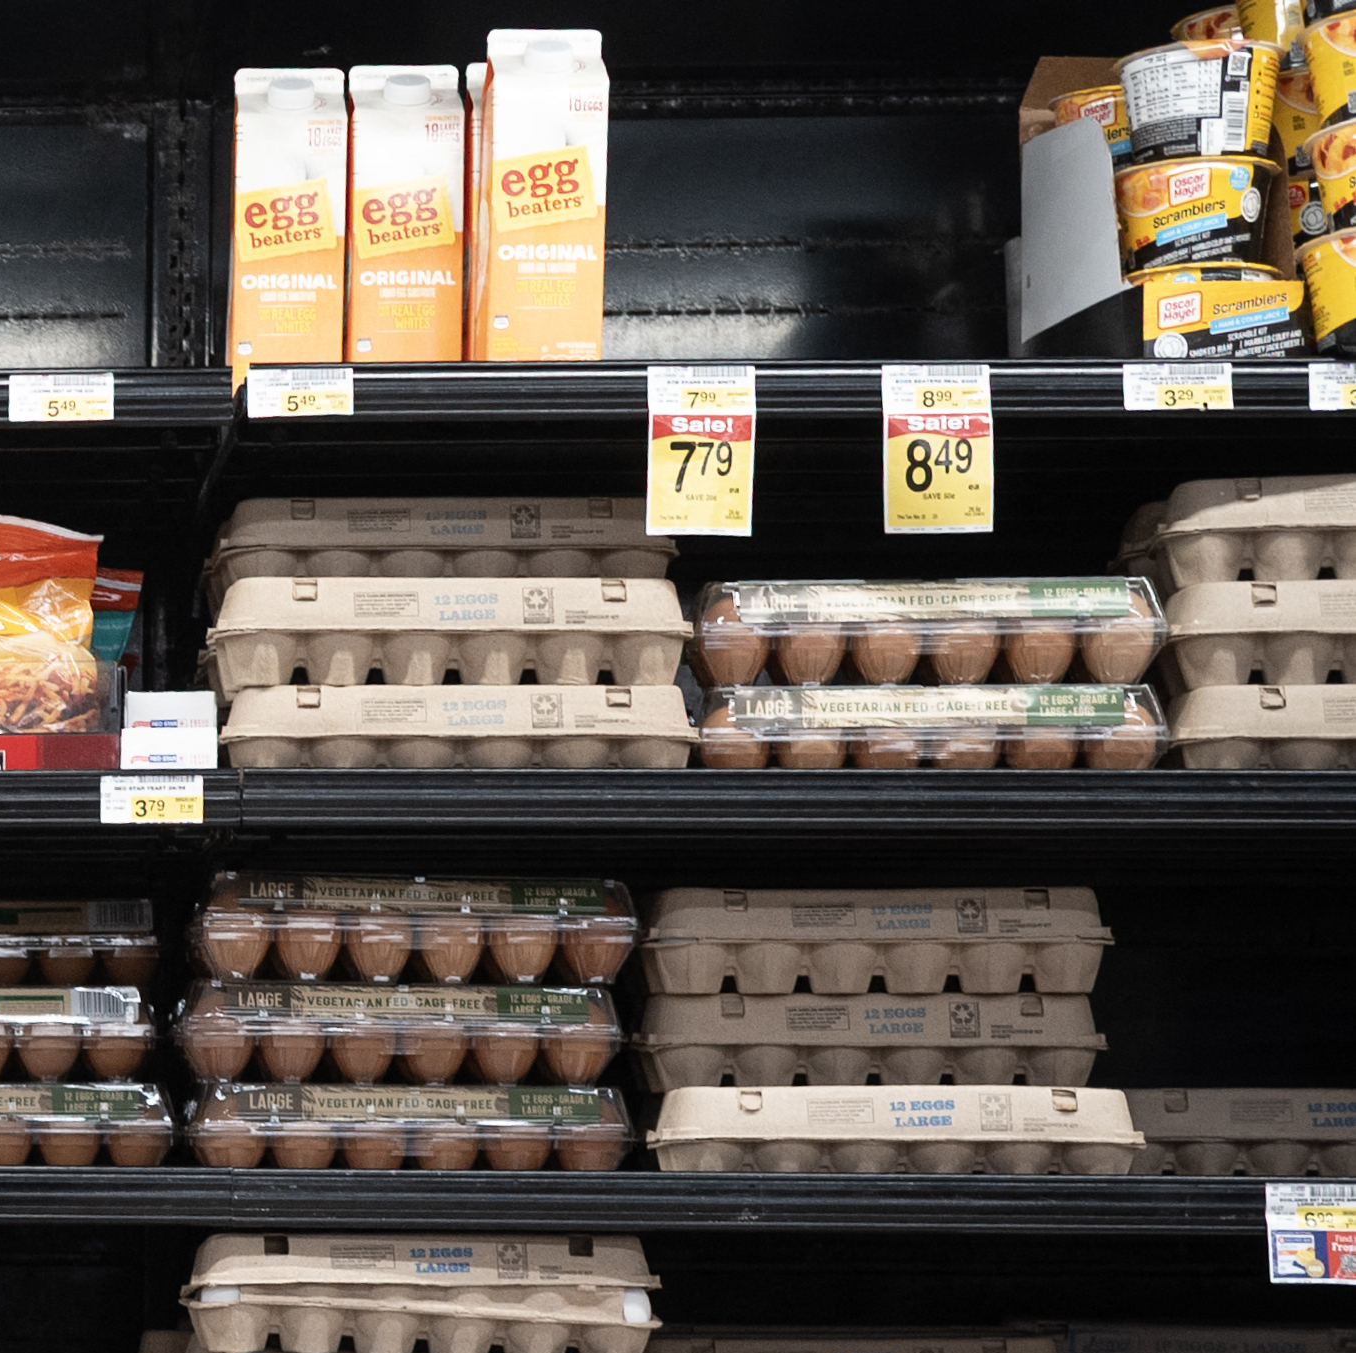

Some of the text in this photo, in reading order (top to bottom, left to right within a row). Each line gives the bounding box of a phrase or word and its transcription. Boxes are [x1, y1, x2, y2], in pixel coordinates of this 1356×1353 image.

[501, 157, 580, 199] egg
[244, 191, 319, 230] egg
[362, 188, 437, 226] egg
[508, 195, 582, 218] beaters
[1153, 200, 1226, 229] Scramblers
[250, 226, 322, 248] beaters
[367, 223, 441, 246] beaters
[497, 244, 598, 261] ORIGINAL
[241, 273, 337, 289] ORIGINAL
[359, 270, 456, 286] ORIGINAL
[1164, 297, 1195, 310] Oscar
[1213, 293, 1288, 315] Scramblers
[271, 309, 316, 319] REAL EGG
[1163, 308, 1196, 322] Mayer
[275, 321, 311, 332] WHITES
[671, 417, 733, 433] Sale!
[907, 415, 970, 431] Sale!
[442, 700, 507, 713] 12 EGGS
[745, 700, 794, 718] LARGE
[819, 701, 1008, 713] VEGETARIAN FED CAGE-FREE
[448, 713, 504, 726] LARGE
[249, 881, 295, 900] LARGE
[889, 1099, 955, 1112] 12 EGGS
[894, 1114, 953, 1127] LARGE
